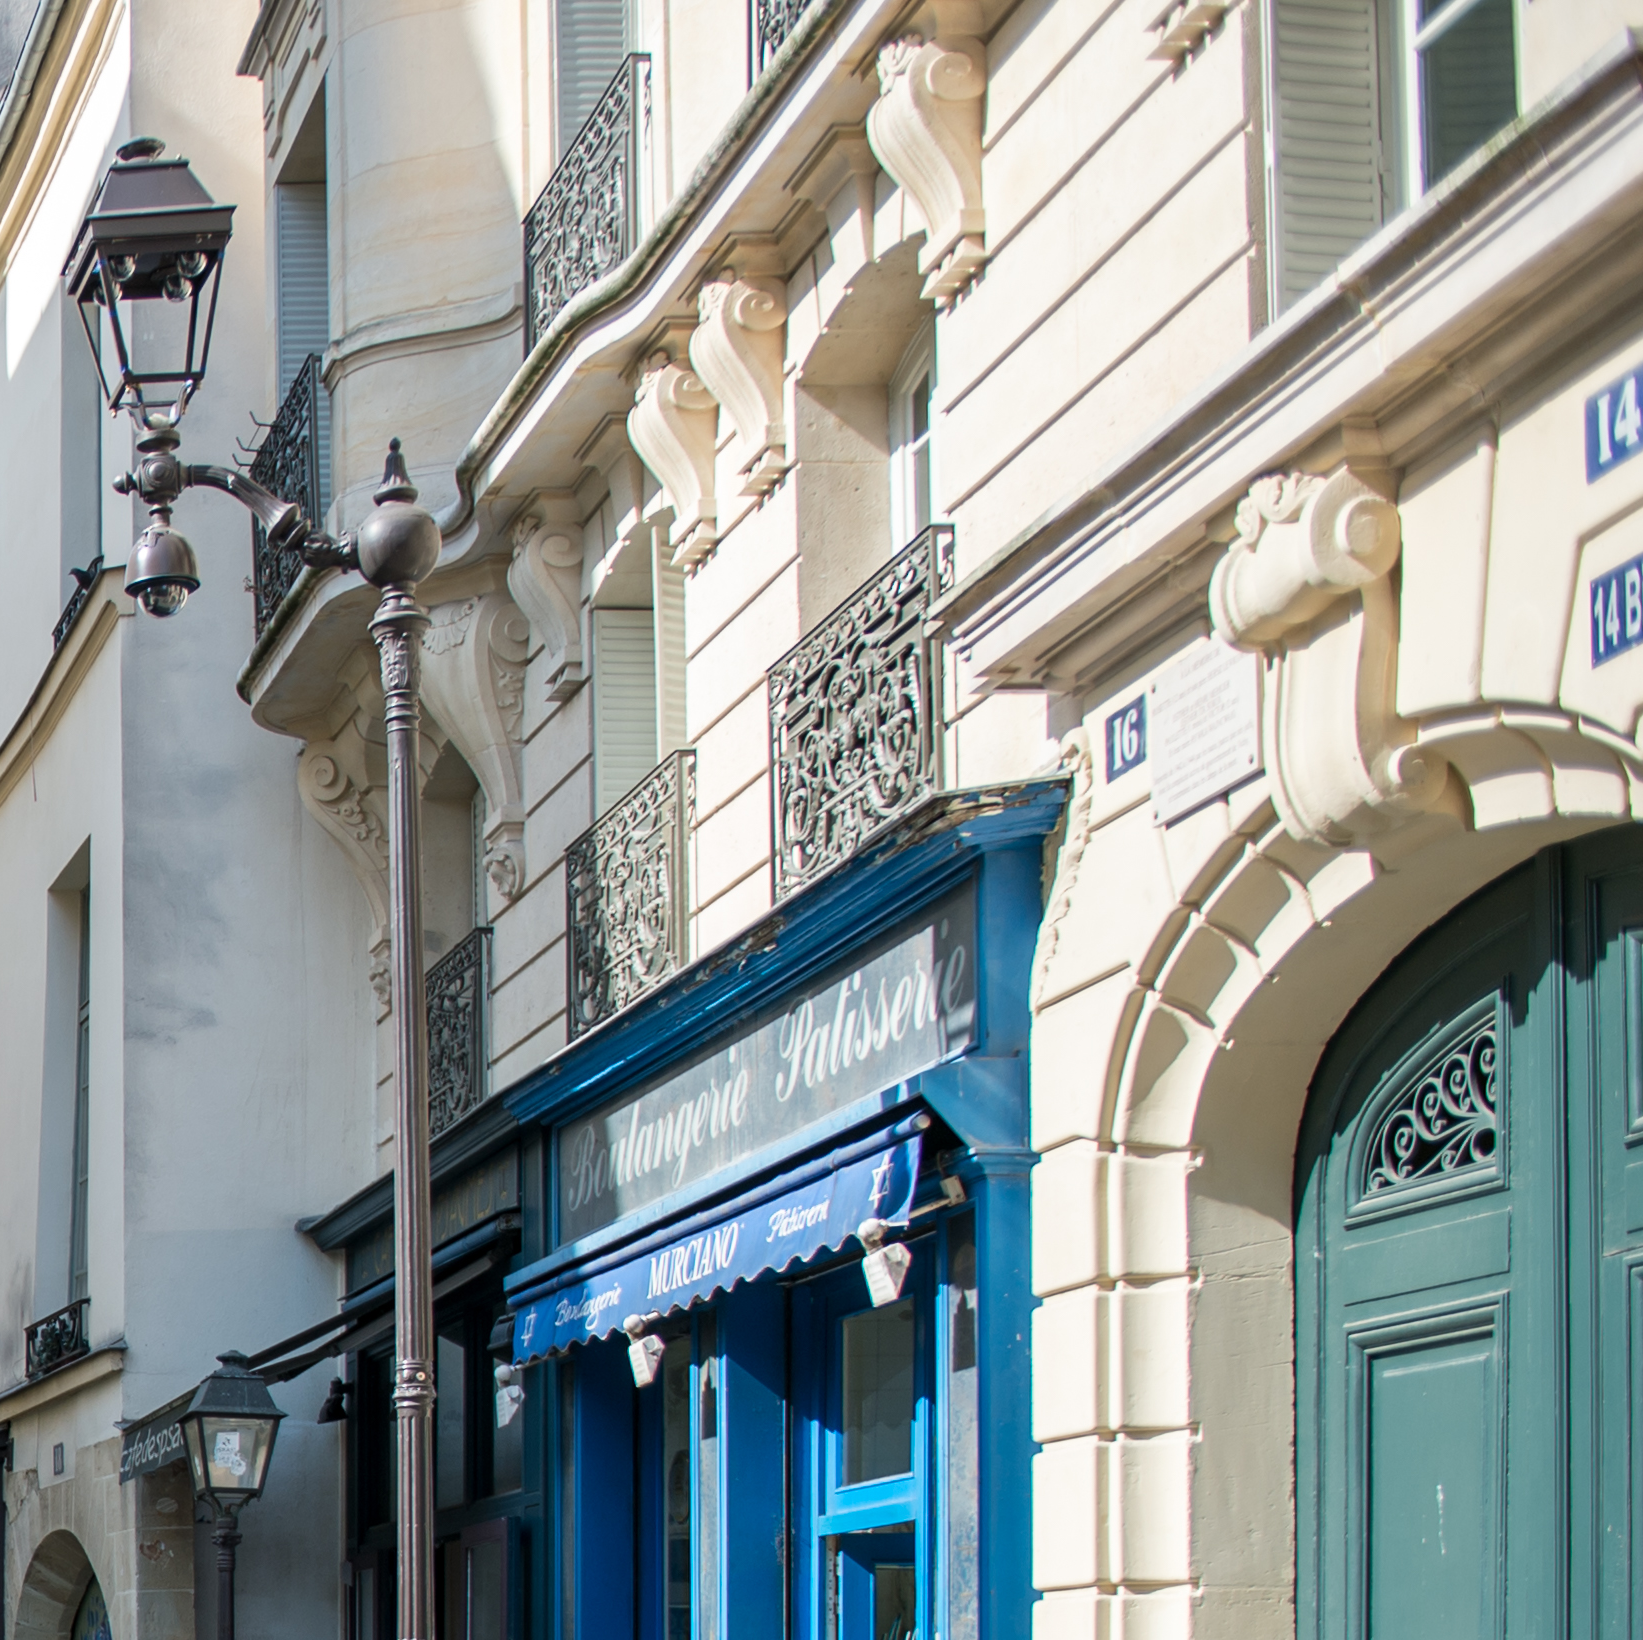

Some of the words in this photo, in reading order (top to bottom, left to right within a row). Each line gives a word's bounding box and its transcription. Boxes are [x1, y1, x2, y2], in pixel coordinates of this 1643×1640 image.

[1597, 376, 1641, 465] 14
[1594, 579, 1619, 654] 14
[1113, 708, 1139, 772] 16
[568, 1044, 751, 1212] Boulangerie
[647, 1221, 739, 1300] MURCIANO
